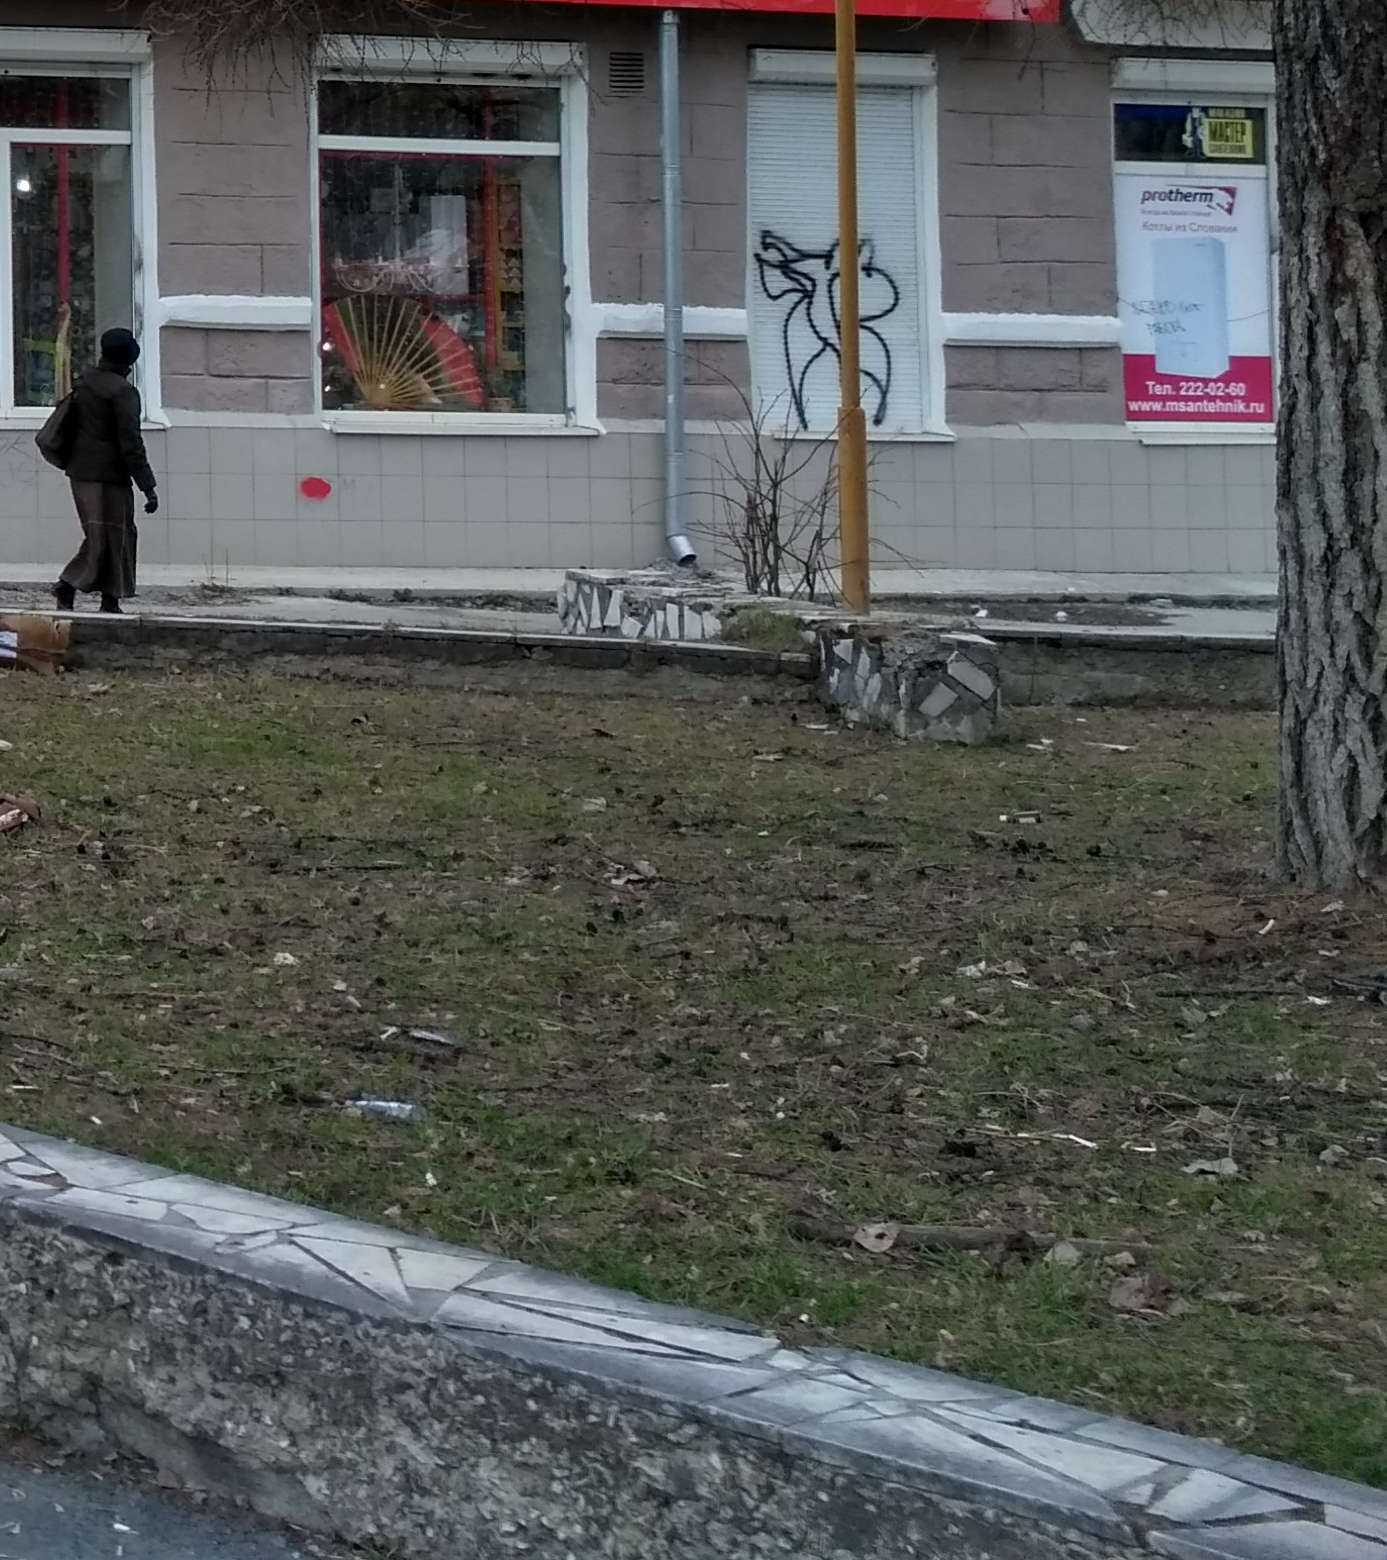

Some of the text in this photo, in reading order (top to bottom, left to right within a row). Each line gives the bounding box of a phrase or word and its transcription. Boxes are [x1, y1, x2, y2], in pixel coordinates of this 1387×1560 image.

[1141, 188, 1213, 204] protherm
[1145, 381, 1246, 396] Тел. 222-02-60
[1128, 399, 1265, 413] www.msantehnik.ru
